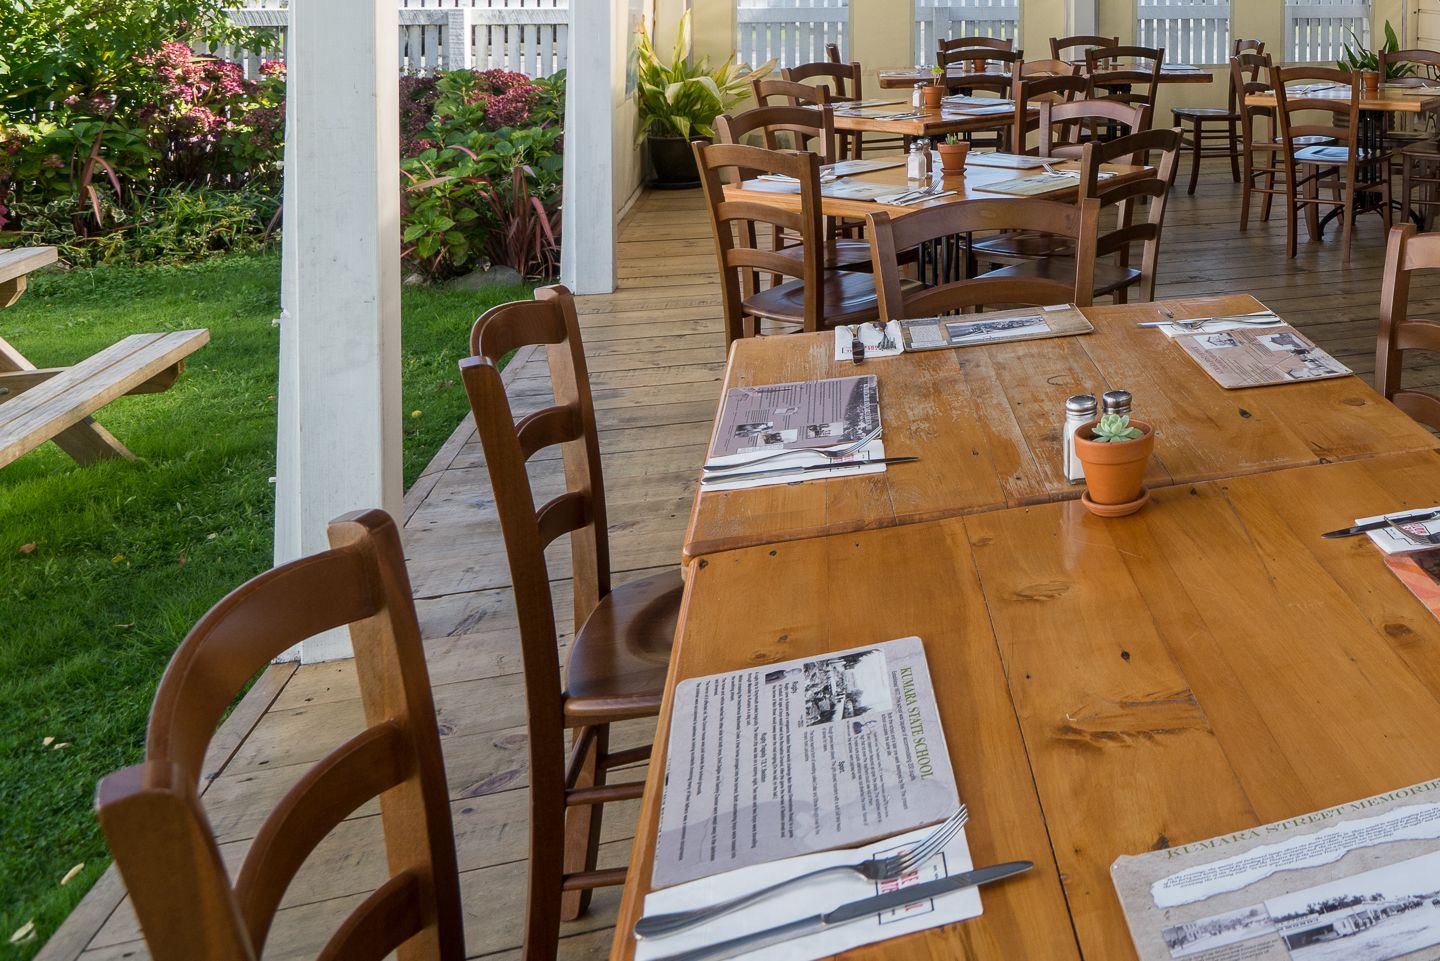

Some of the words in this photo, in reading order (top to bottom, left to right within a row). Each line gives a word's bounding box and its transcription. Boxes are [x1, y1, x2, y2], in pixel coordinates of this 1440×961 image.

[900, 665, 917, 706] KUMARA
[908, 707, 924, 736] STATE
[913, 737, 933, 780] SCHOOL
[1166, 830, 1260, 859] KUMARA
[1265, 806, 1345, 834] STREET
